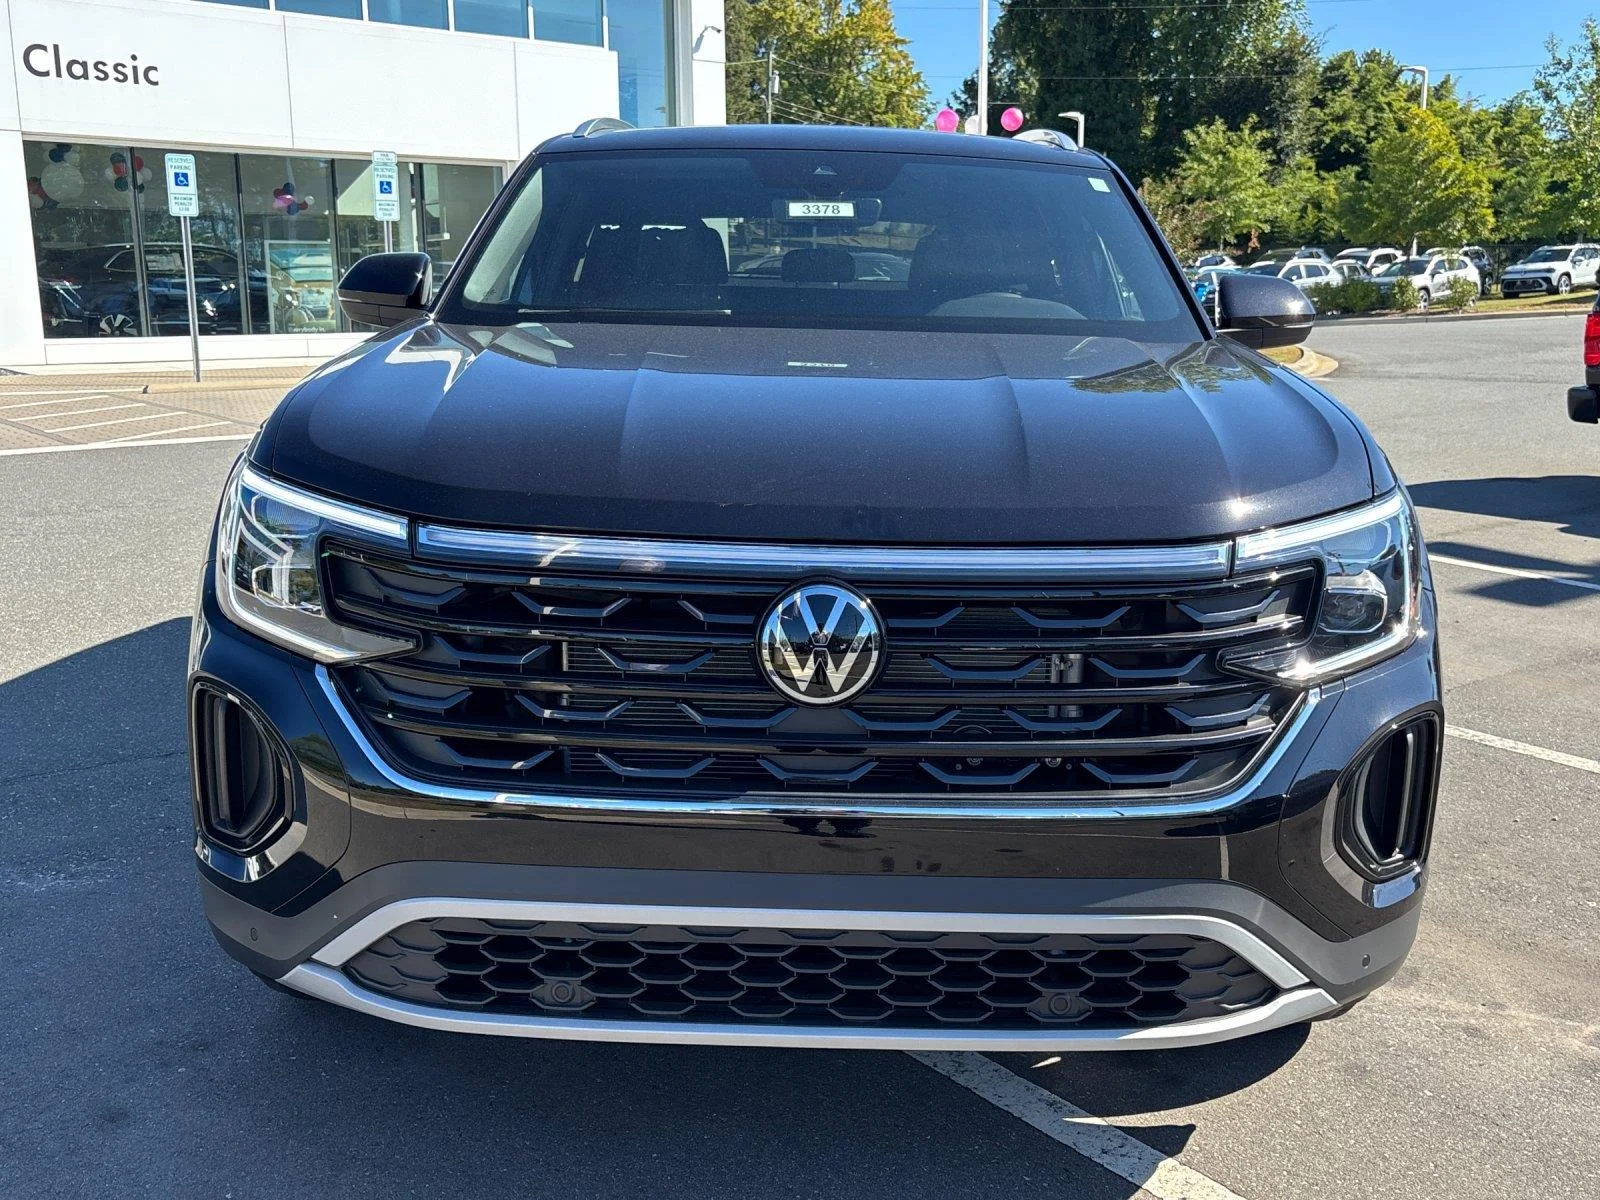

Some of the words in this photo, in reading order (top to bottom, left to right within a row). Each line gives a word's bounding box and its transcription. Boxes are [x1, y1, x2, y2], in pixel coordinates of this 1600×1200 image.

[23, 43, 159, 86] Classic
[801, 204, 841, 215] 3378
[762, 584, 880, 704] VW
